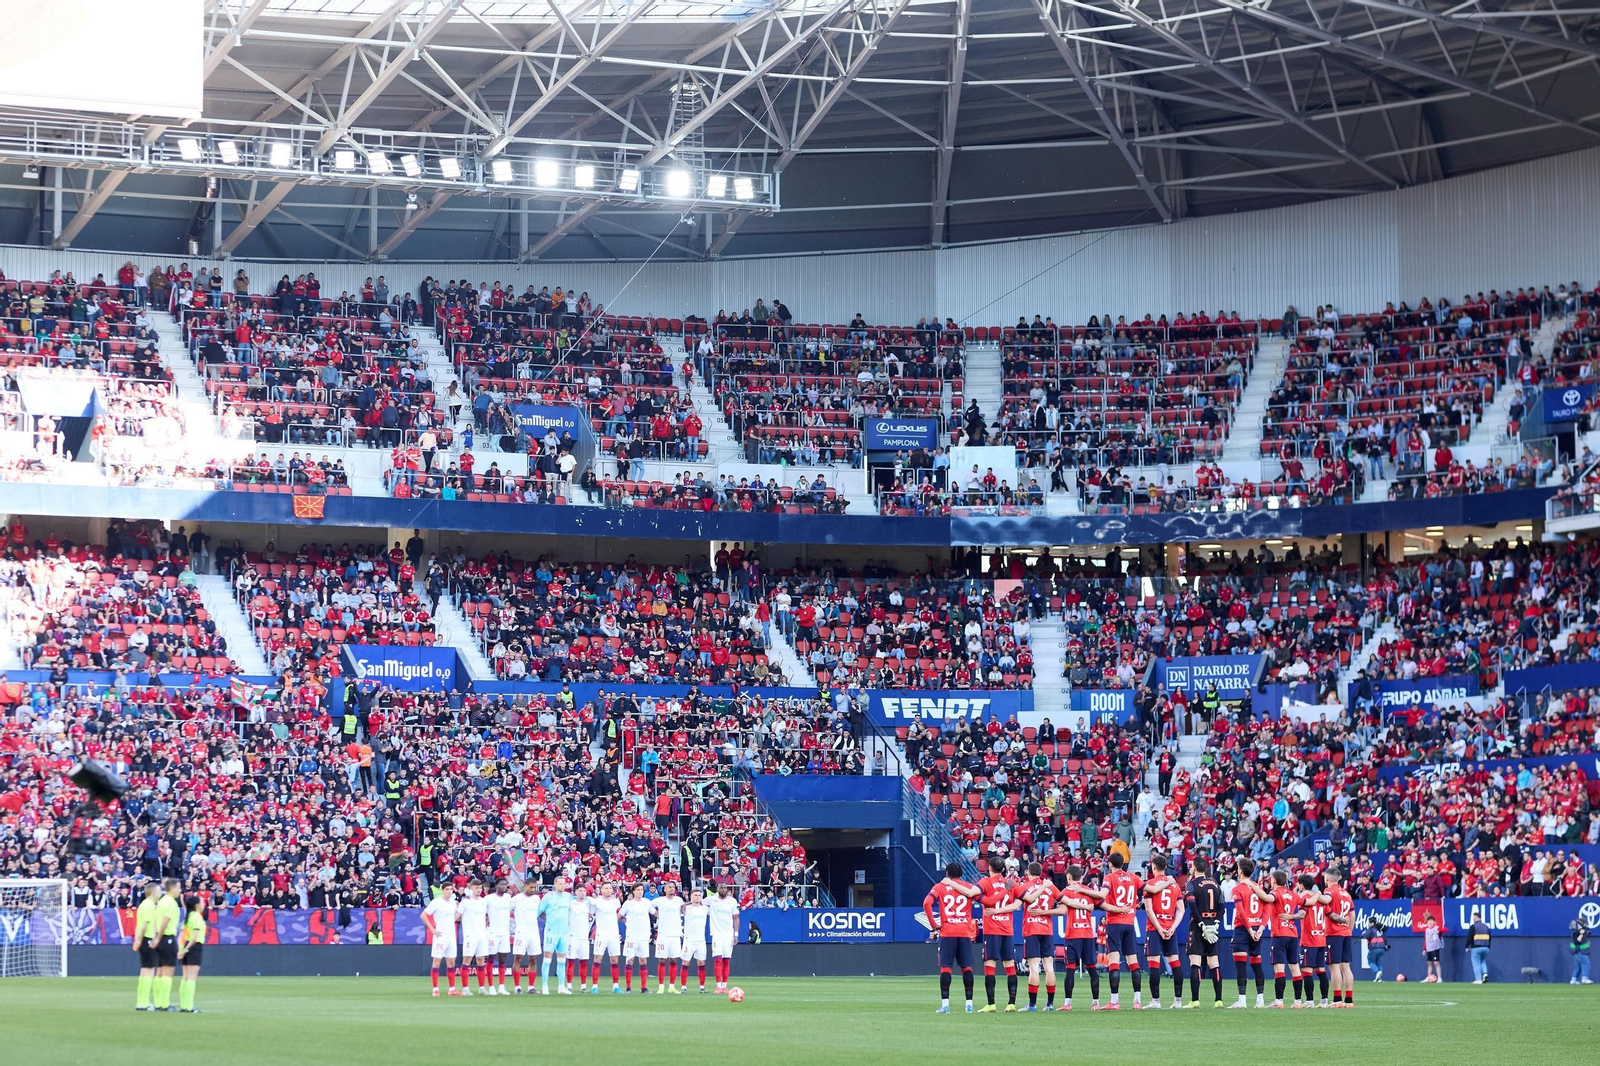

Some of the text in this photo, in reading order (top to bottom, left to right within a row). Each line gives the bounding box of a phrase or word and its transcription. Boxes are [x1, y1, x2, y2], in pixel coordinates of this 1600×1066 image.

[890, 425, 928, 433] LEXUS
[883, 439, 920, 447] PAMPLONA
[357, 659, 433, 681] SanMiguel
[1169, 670, 1187, 682] DN
[1193, 664, 1250, 676] DIARIO DE
[1193, 677, 1251, 691] NAVARRA
[881, 697, 991, 719] FENDT
[1090, 692, 1125, 711] ROOM
[943, 894, 968, 917] 22
[1115, 885, 1135, 907] 24
[1161, 888, 1172, 910] 5
[1207, 888, 1214, 910] 1
[1250, 893, 1259, 914] 6
[1312, 905, 1326, 930] 14
[1459, 903, 1519, 930] LALIGA
